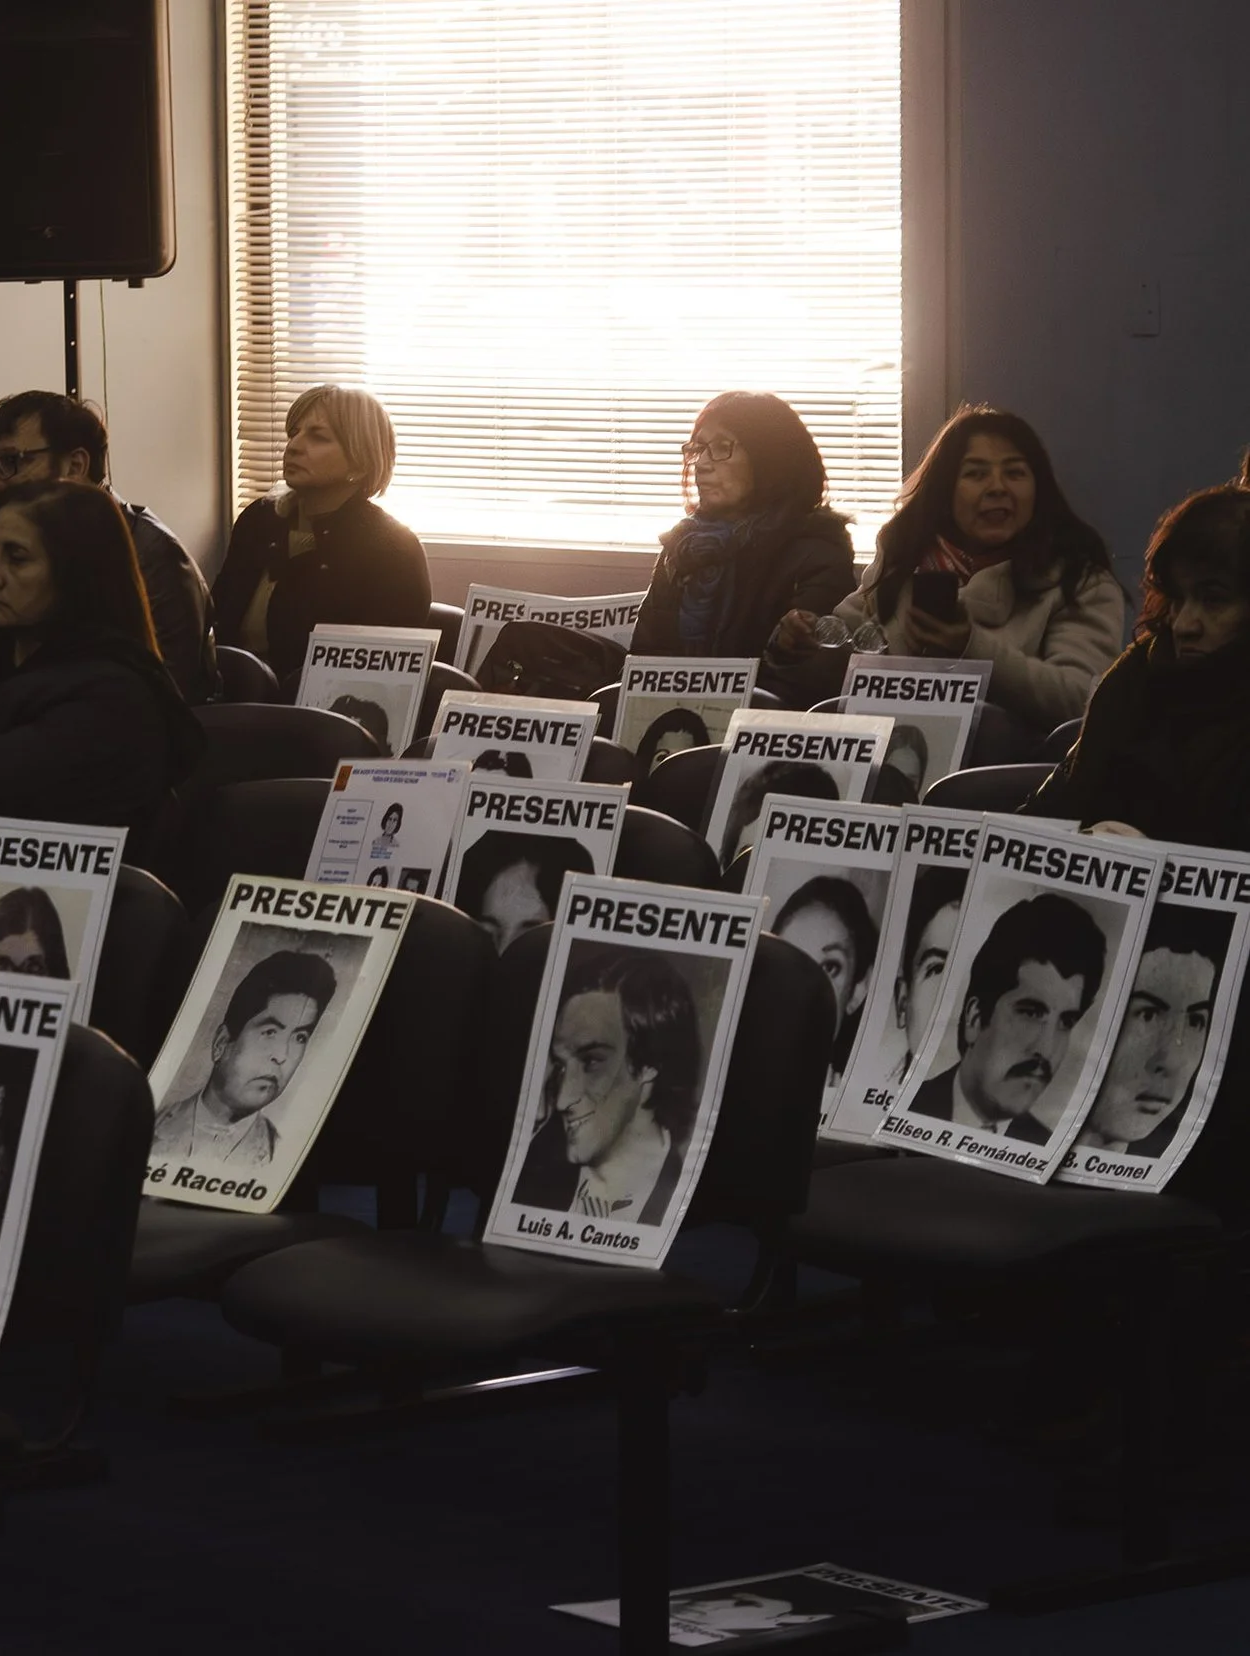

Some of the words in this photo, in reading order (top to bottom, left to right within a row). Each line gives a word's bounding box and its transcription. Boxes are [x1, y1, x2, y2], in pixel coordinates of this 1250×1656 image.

[311, 645, 424, 673] PRESENTE
[627, 670, 748, 693] PRESENTE
[851, 674, 979, 703] PRESENTE
[442, 711, 582, 747] PRESENTE
[732, 731, 875, 763] PRESENTE
[467, 790, 617, 831] PRESENTE
[982, 834, 1151, 898] PRESENTE
[230, 883, 408, 929] PRESENTE
[567, 894, 752, 948] PRESENTE
[882, 1116, 932, 1140] Eliseo
[936, 1130, 953, 1147] R.
[956, 1136, 1050, 1171] Fernández
[172, 1167, 267, 1201] Racedo
[1085, 1155, 1152, 1180] Coronel
[517, 1213, 552, 1236] Luis
[556, 1221, 574, 1240] A.
[581, 1225, 640, 1250] Cantos
[803, 1566, 972, 1611] PRESENTE
